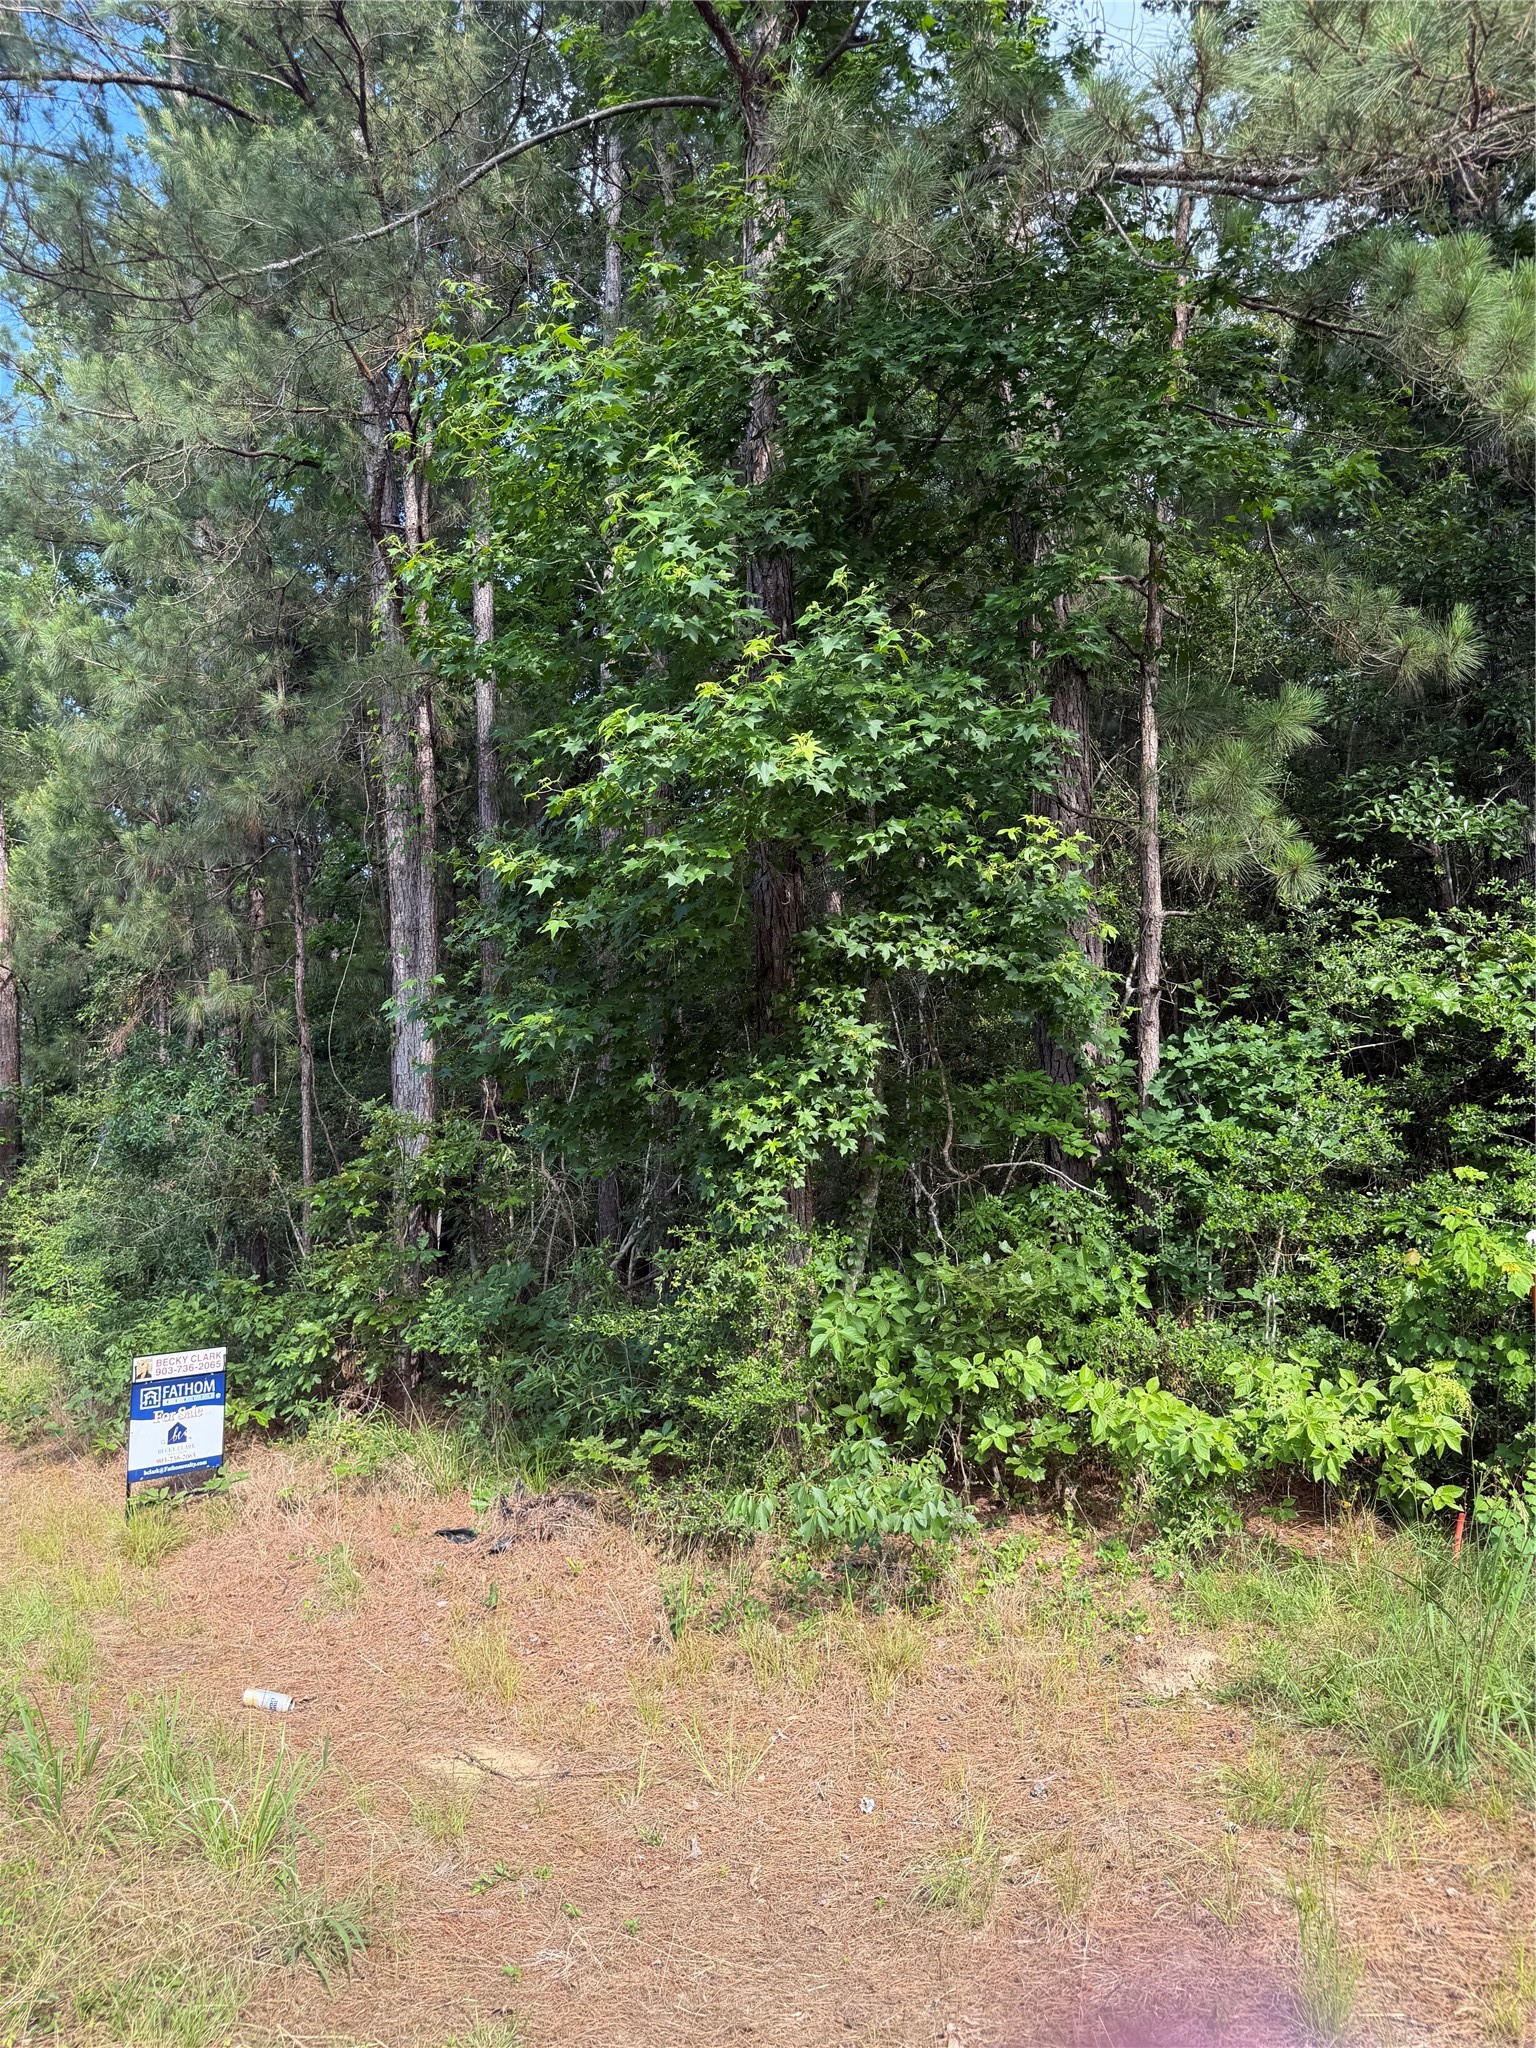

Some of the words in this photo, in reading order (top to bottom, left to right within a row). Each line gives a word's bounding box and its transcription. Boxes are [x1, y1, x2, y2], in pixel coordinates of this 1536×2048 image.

[155, 1360, 222, 1377] 903-736-2065
[156, 1355, 189, 1368] BECKY
[190, 1351, 222, 1364] CLARK
[162, 1379, 216, 1399] FATHOM
[153, 1410, 177, 1424] For
[177, 1405, 204, 1420] Sale
